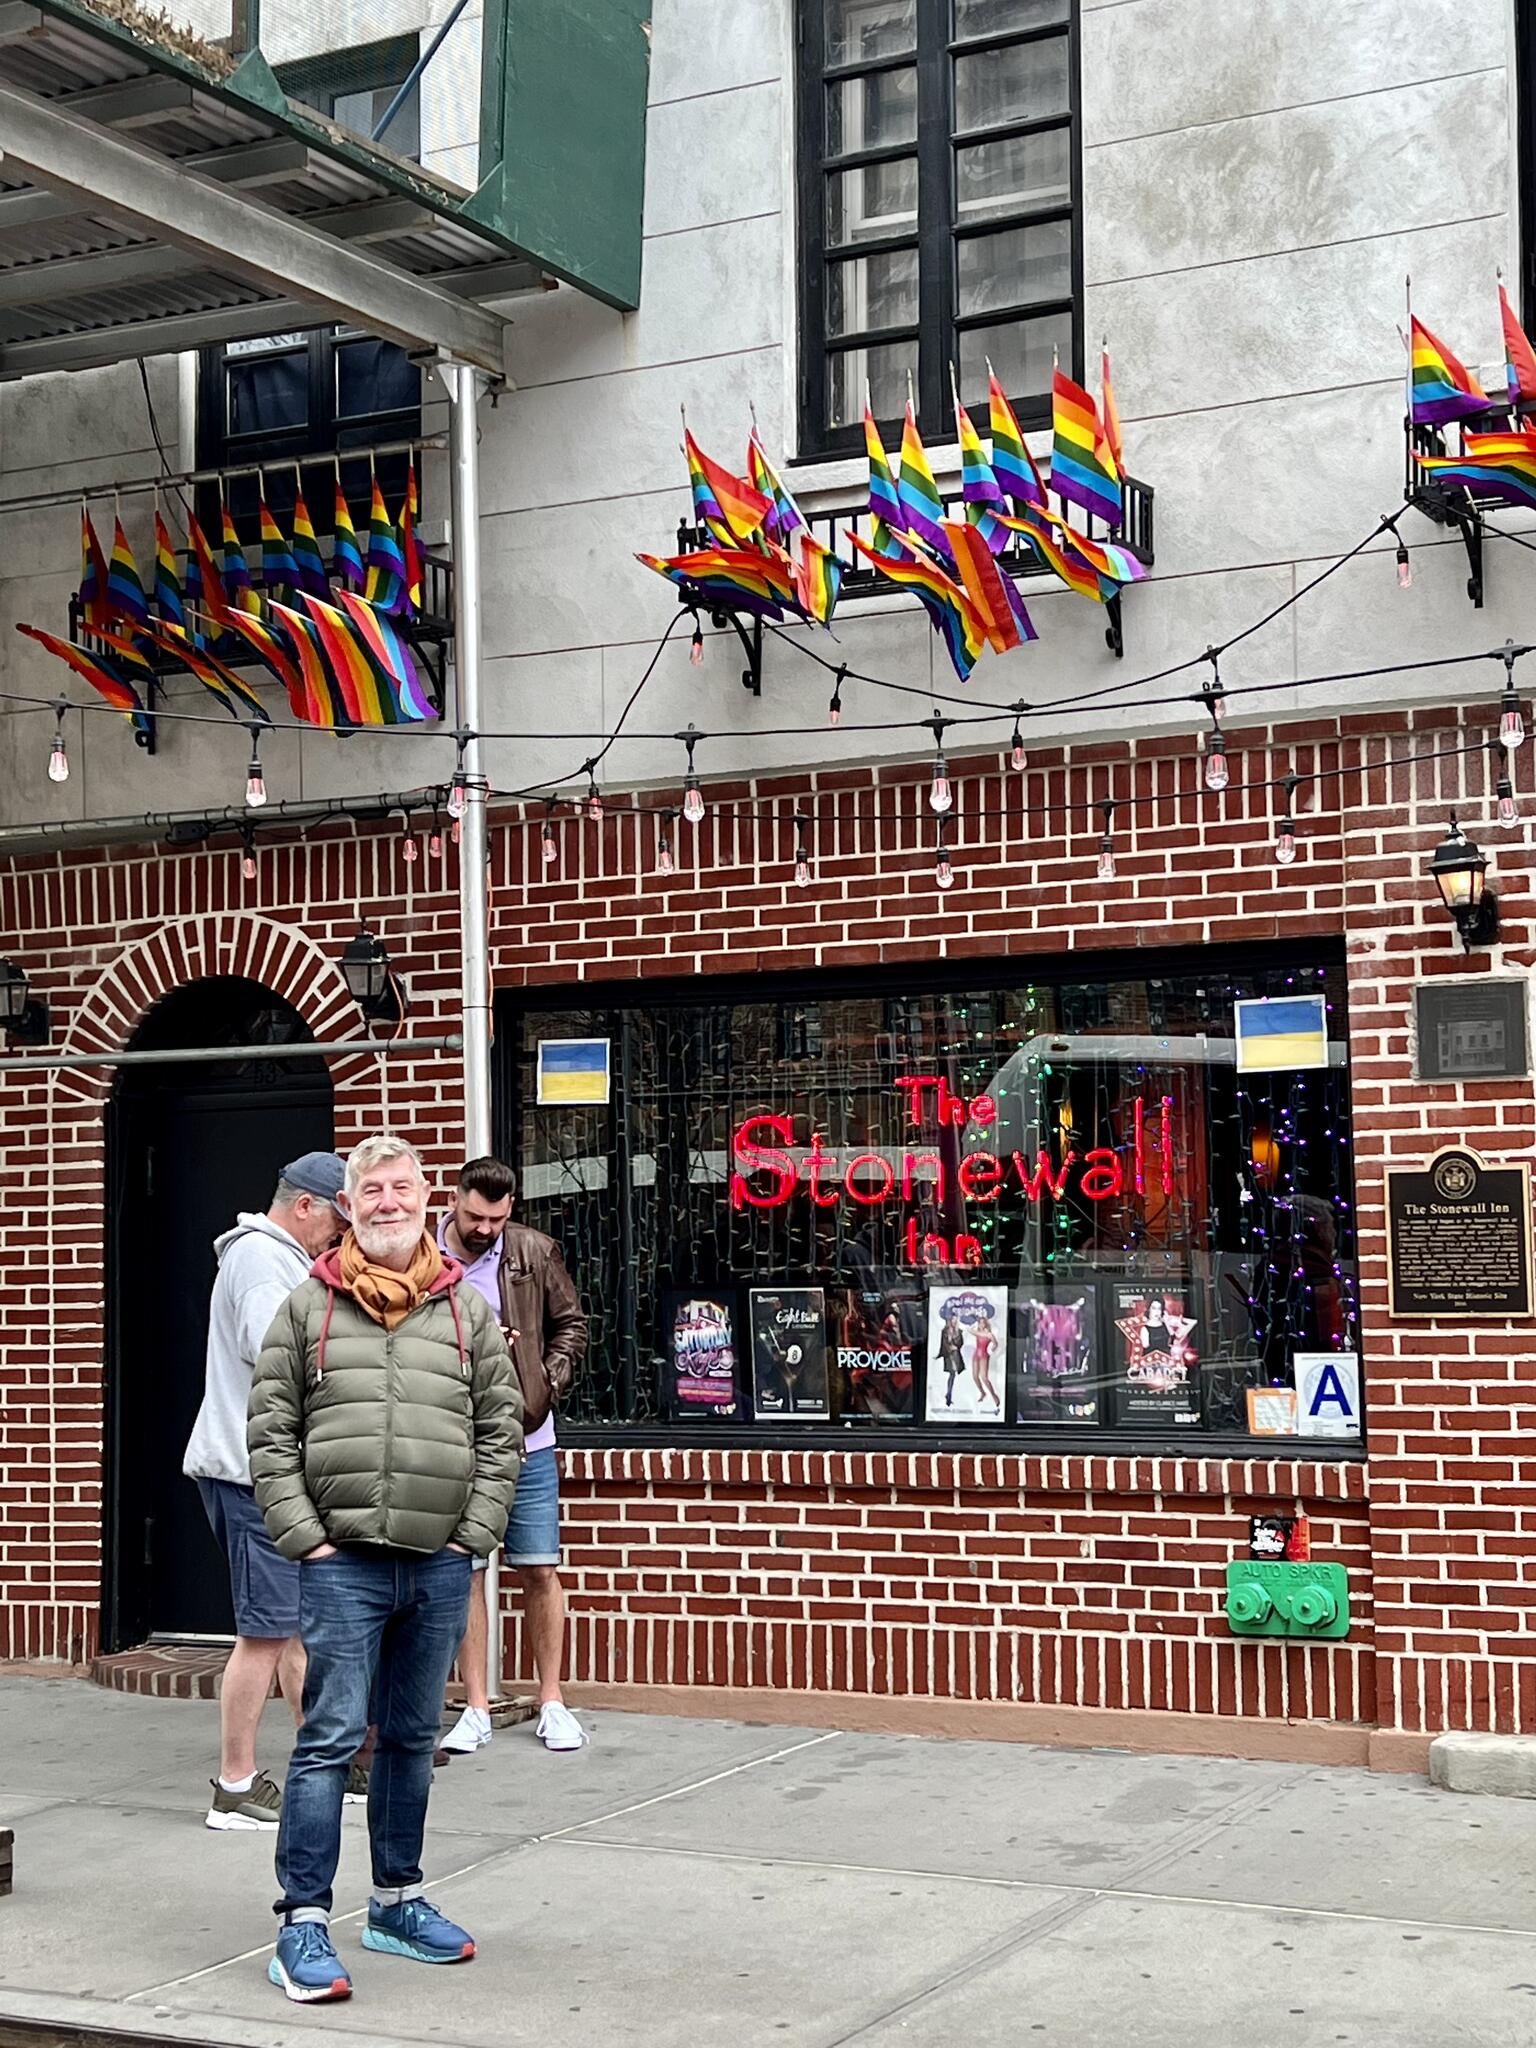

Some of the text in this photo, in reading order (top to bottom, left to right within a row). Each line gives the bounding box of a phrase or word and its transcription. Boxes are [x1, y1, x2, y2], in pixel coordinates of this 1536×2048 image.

[895, 1075, 998, 1127] The
[732, 1095, 1173, 1211] Stonewall
[1404, 1202, 1510, 1215] The Stonewall Inn
[905, 1217, 984, 1266] Inn
[836, 1350, 912, 1371] PROVOKE
[1126, 1366, 1188, 1381] CABARET
[1308, 1364, 1354, 1417] A
[1241, 1562, 1333, 1580] AUTO SPKR
